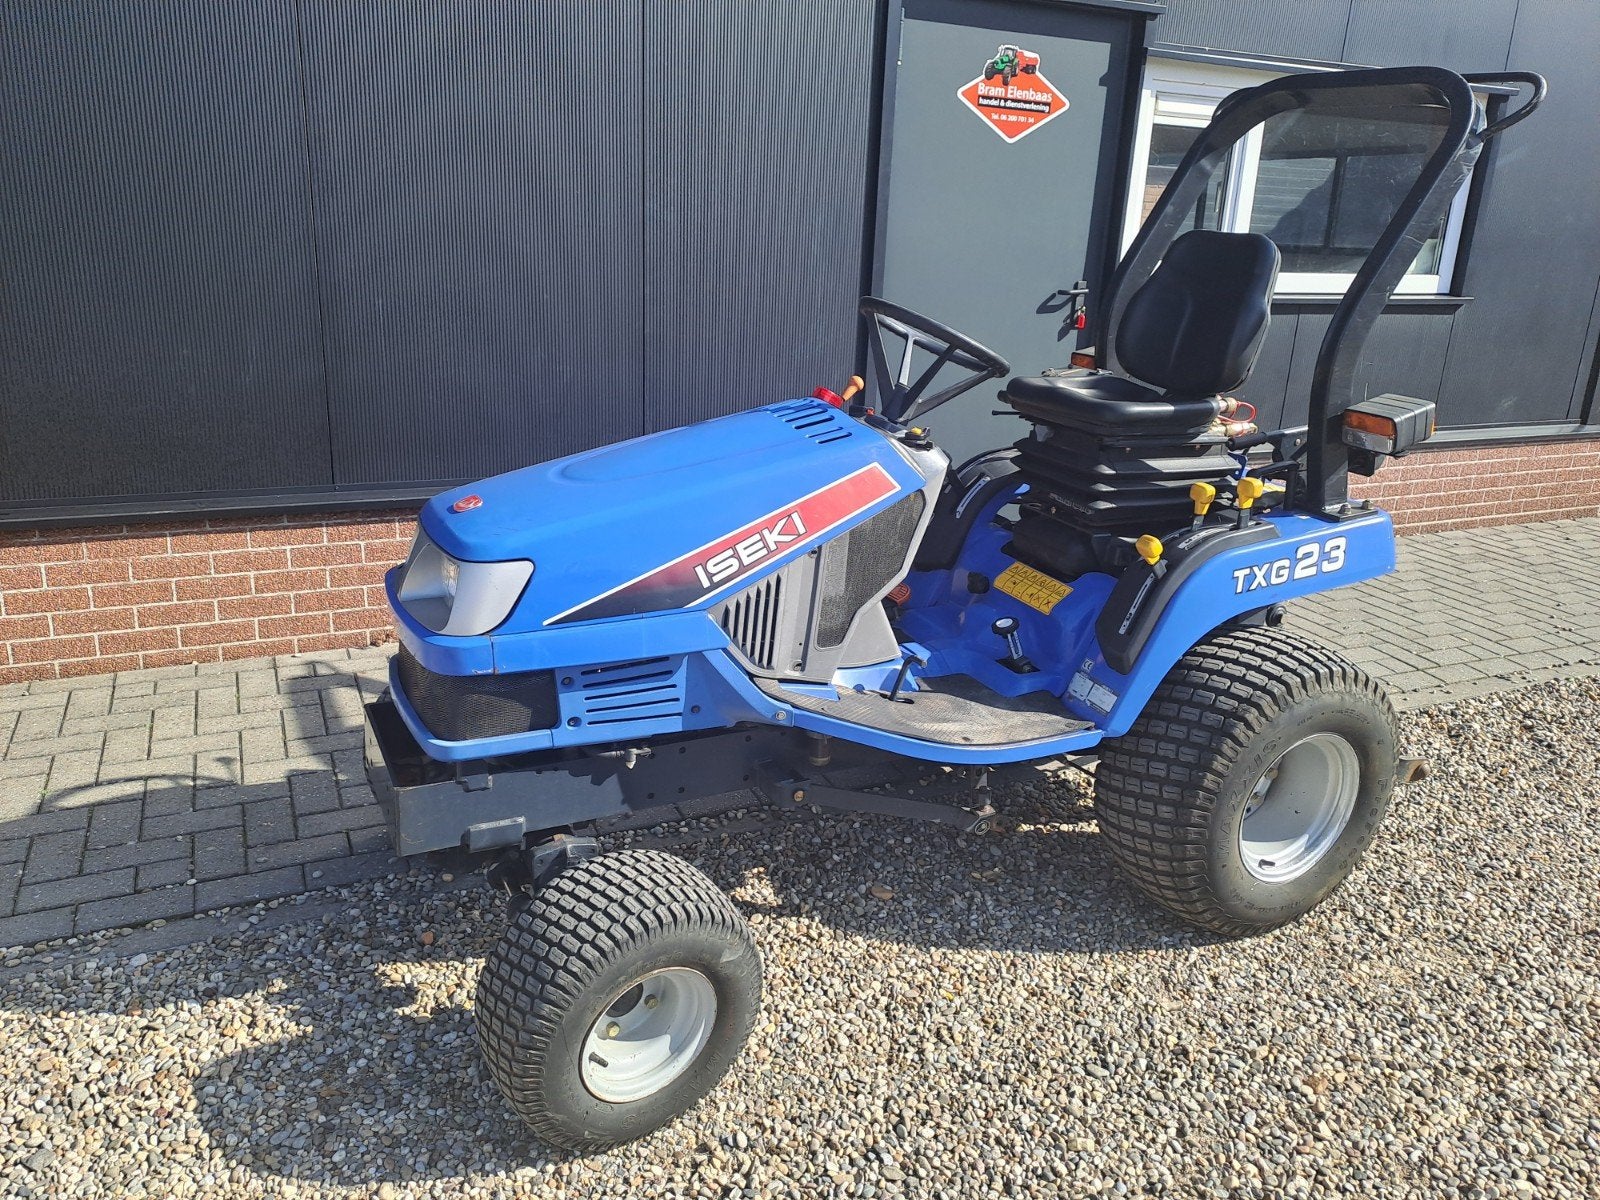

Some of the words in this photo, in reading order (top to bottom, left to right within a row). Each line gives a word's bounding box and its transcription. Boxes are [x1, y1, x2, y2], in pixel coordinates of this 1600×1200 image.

[977, 82, 1005, 96] Bram
[1007, 85, 1052, 102] Elenbaas
[979, 97, 1000, 106] handel
[1005, 100, 1049, 112] dienstverlening
[694, 510, 807, 589] ISEKI
[1232, 558, 1290, 594] TXG
[1293, 535, 1347, 580] 23
